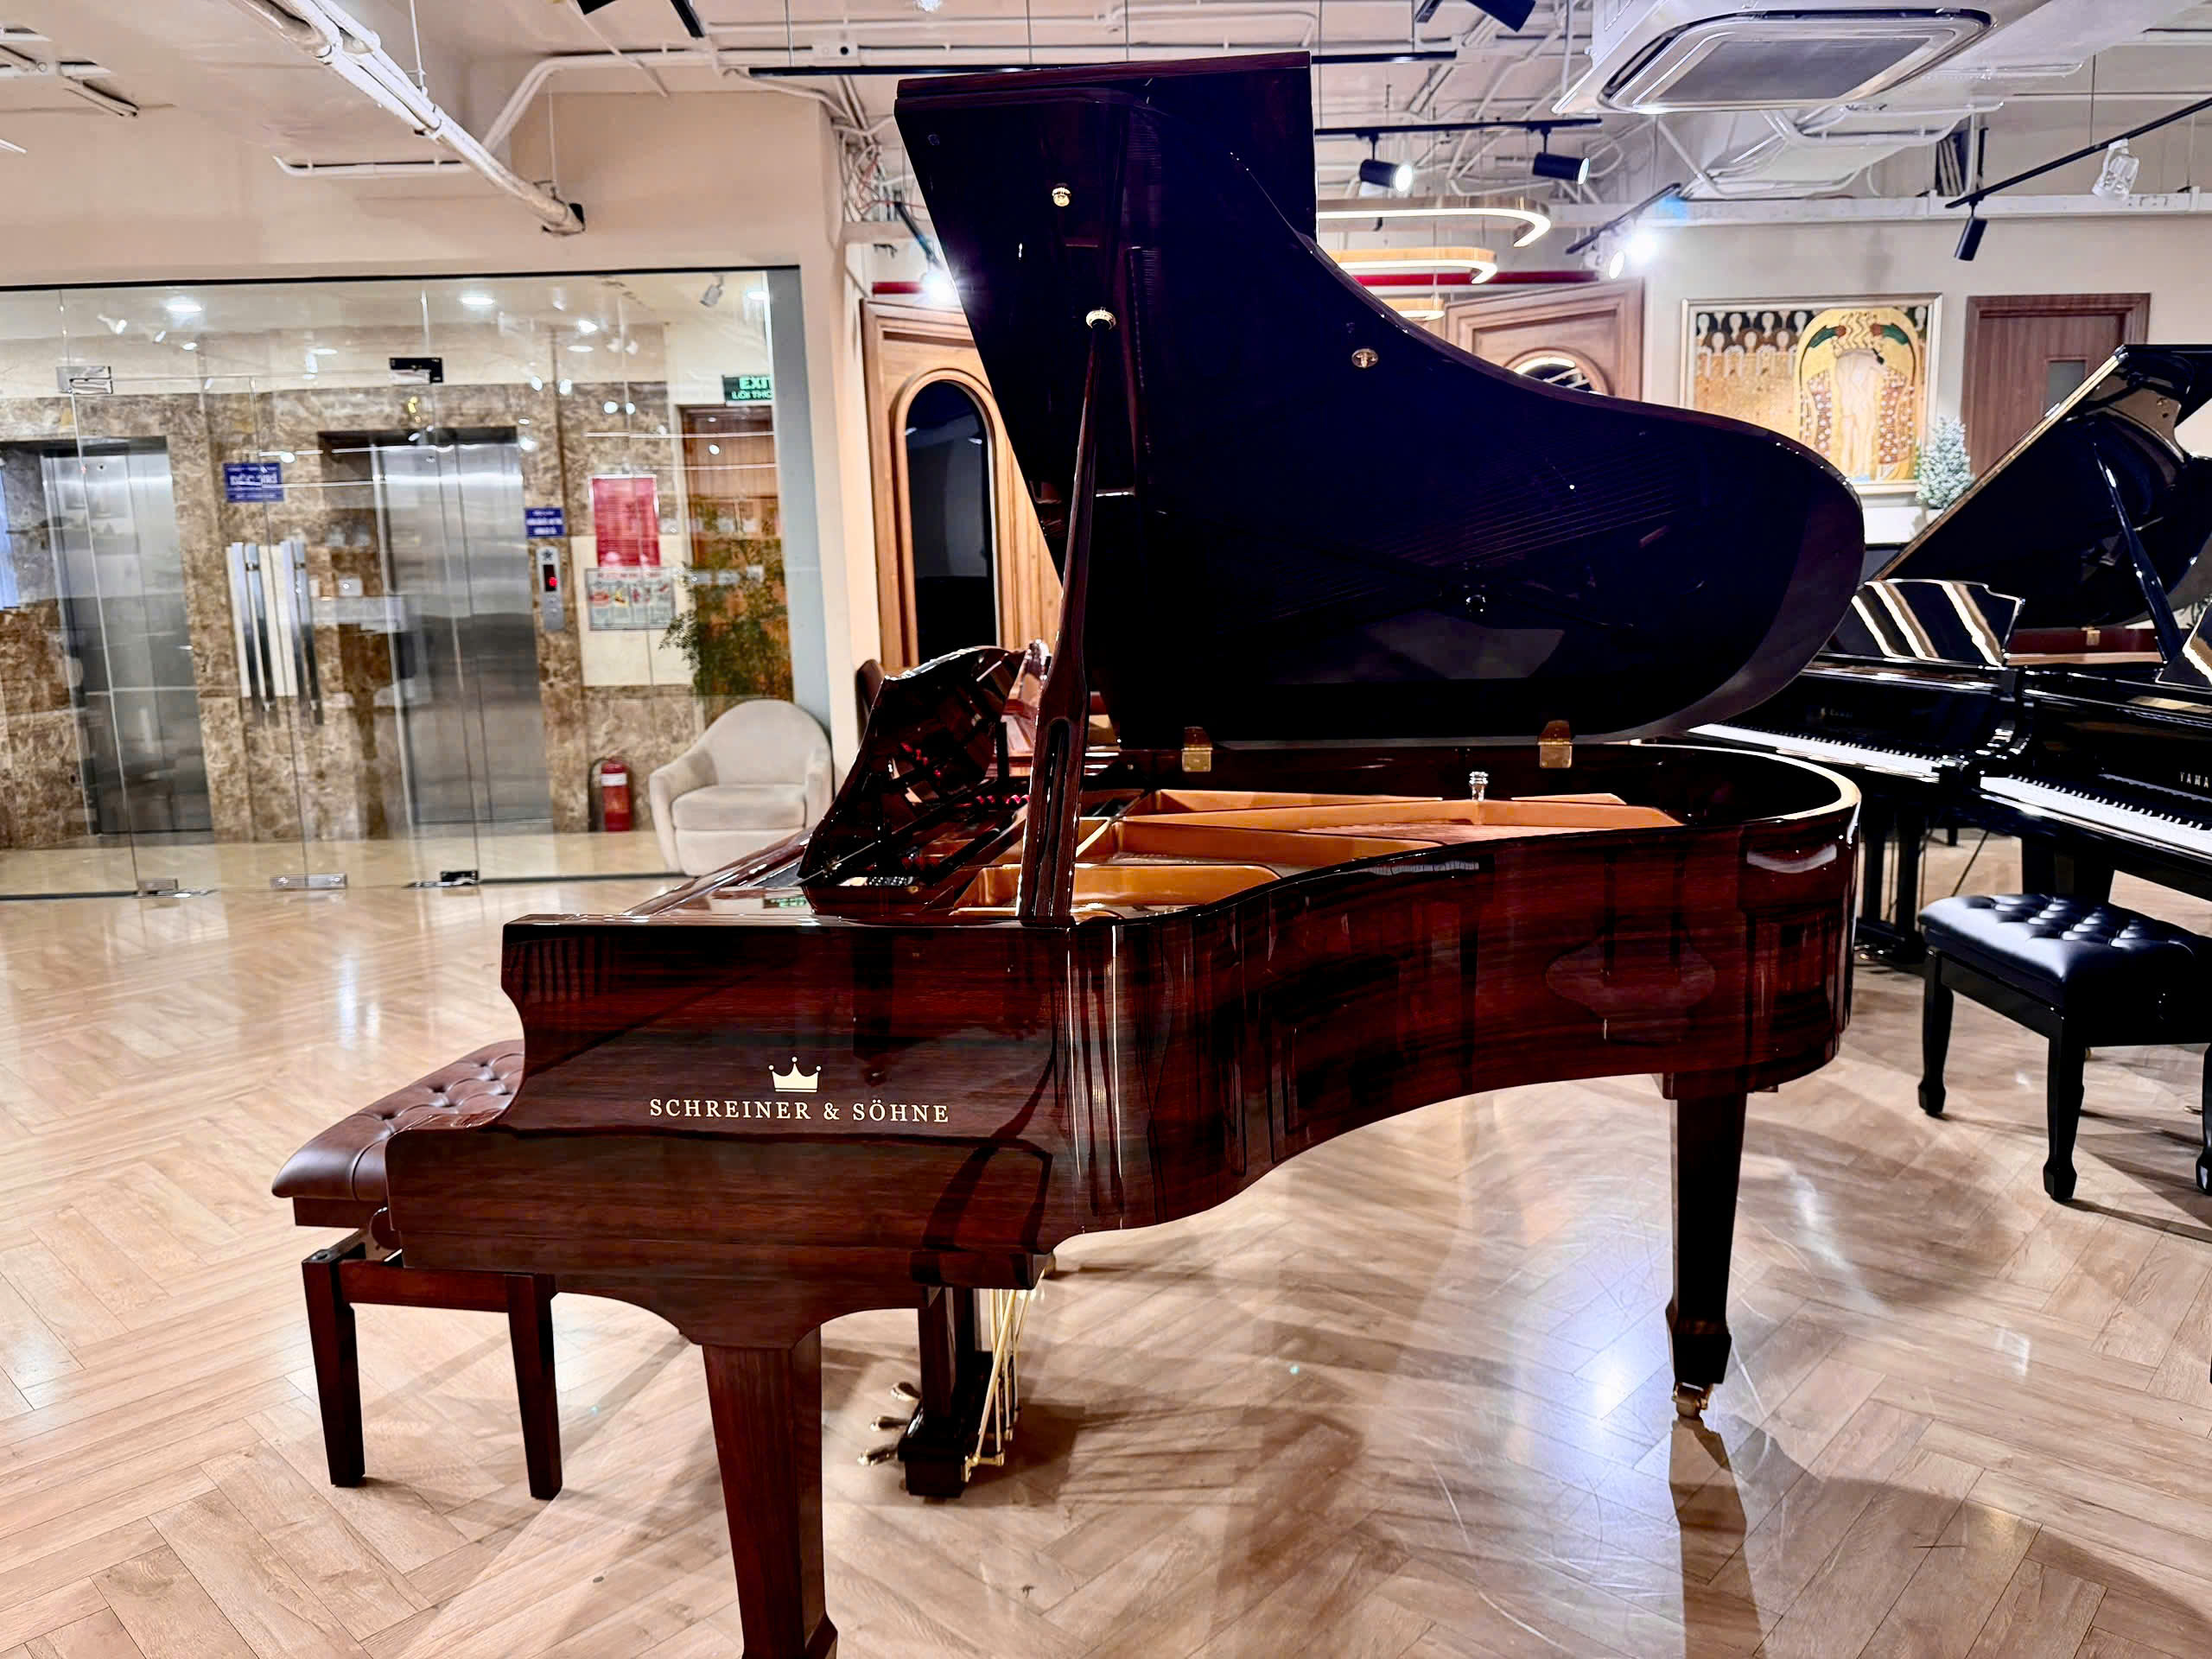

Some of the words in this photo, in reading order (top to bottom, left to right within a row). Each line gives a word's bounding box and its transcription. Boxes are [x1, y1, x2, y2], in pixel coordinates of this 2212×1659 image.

[650, 1098, 811, 1120] SCHREINER
[823, 1102, 840, 1121] &
[853, 1099, 949, 1122] SÖHNE
